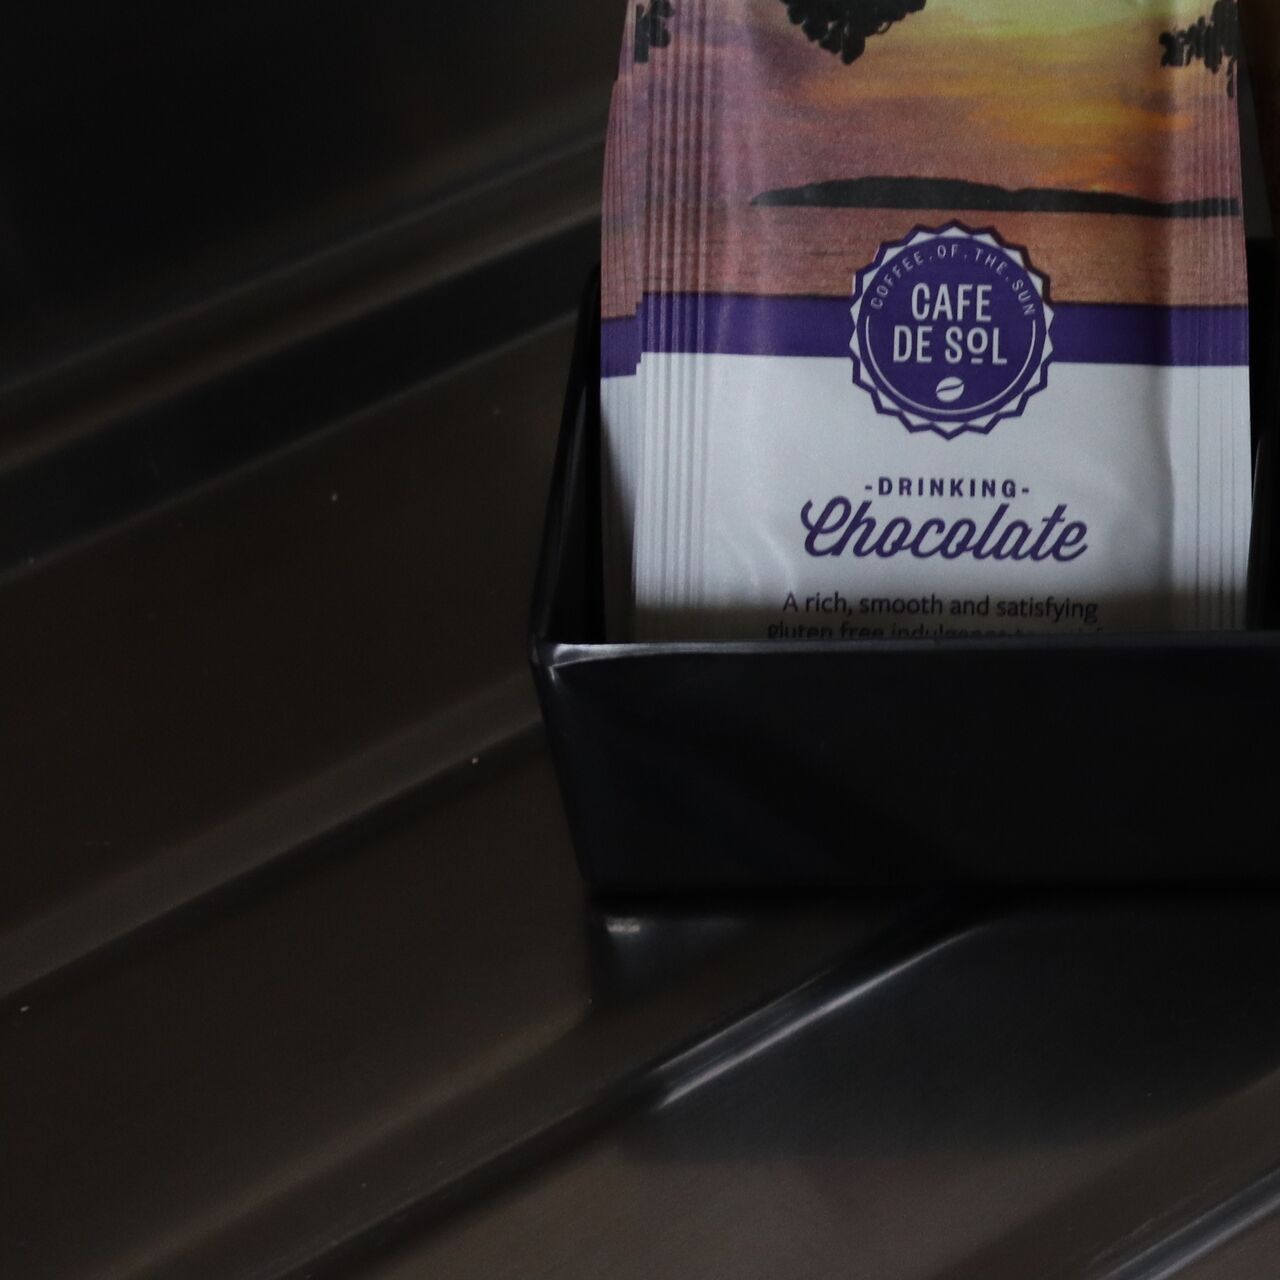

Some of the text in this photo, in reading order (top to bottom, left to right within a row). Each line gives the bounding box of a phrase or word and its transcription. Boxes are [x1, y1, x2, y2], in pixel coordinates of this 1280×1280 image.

[910, 281, 993, 323] CAFE
[892, 324, 934, 365] DE
[800, 495, 1089, 562] Chocolate
[782, 591, 1099, 624] A rich, smooth and satisfying
